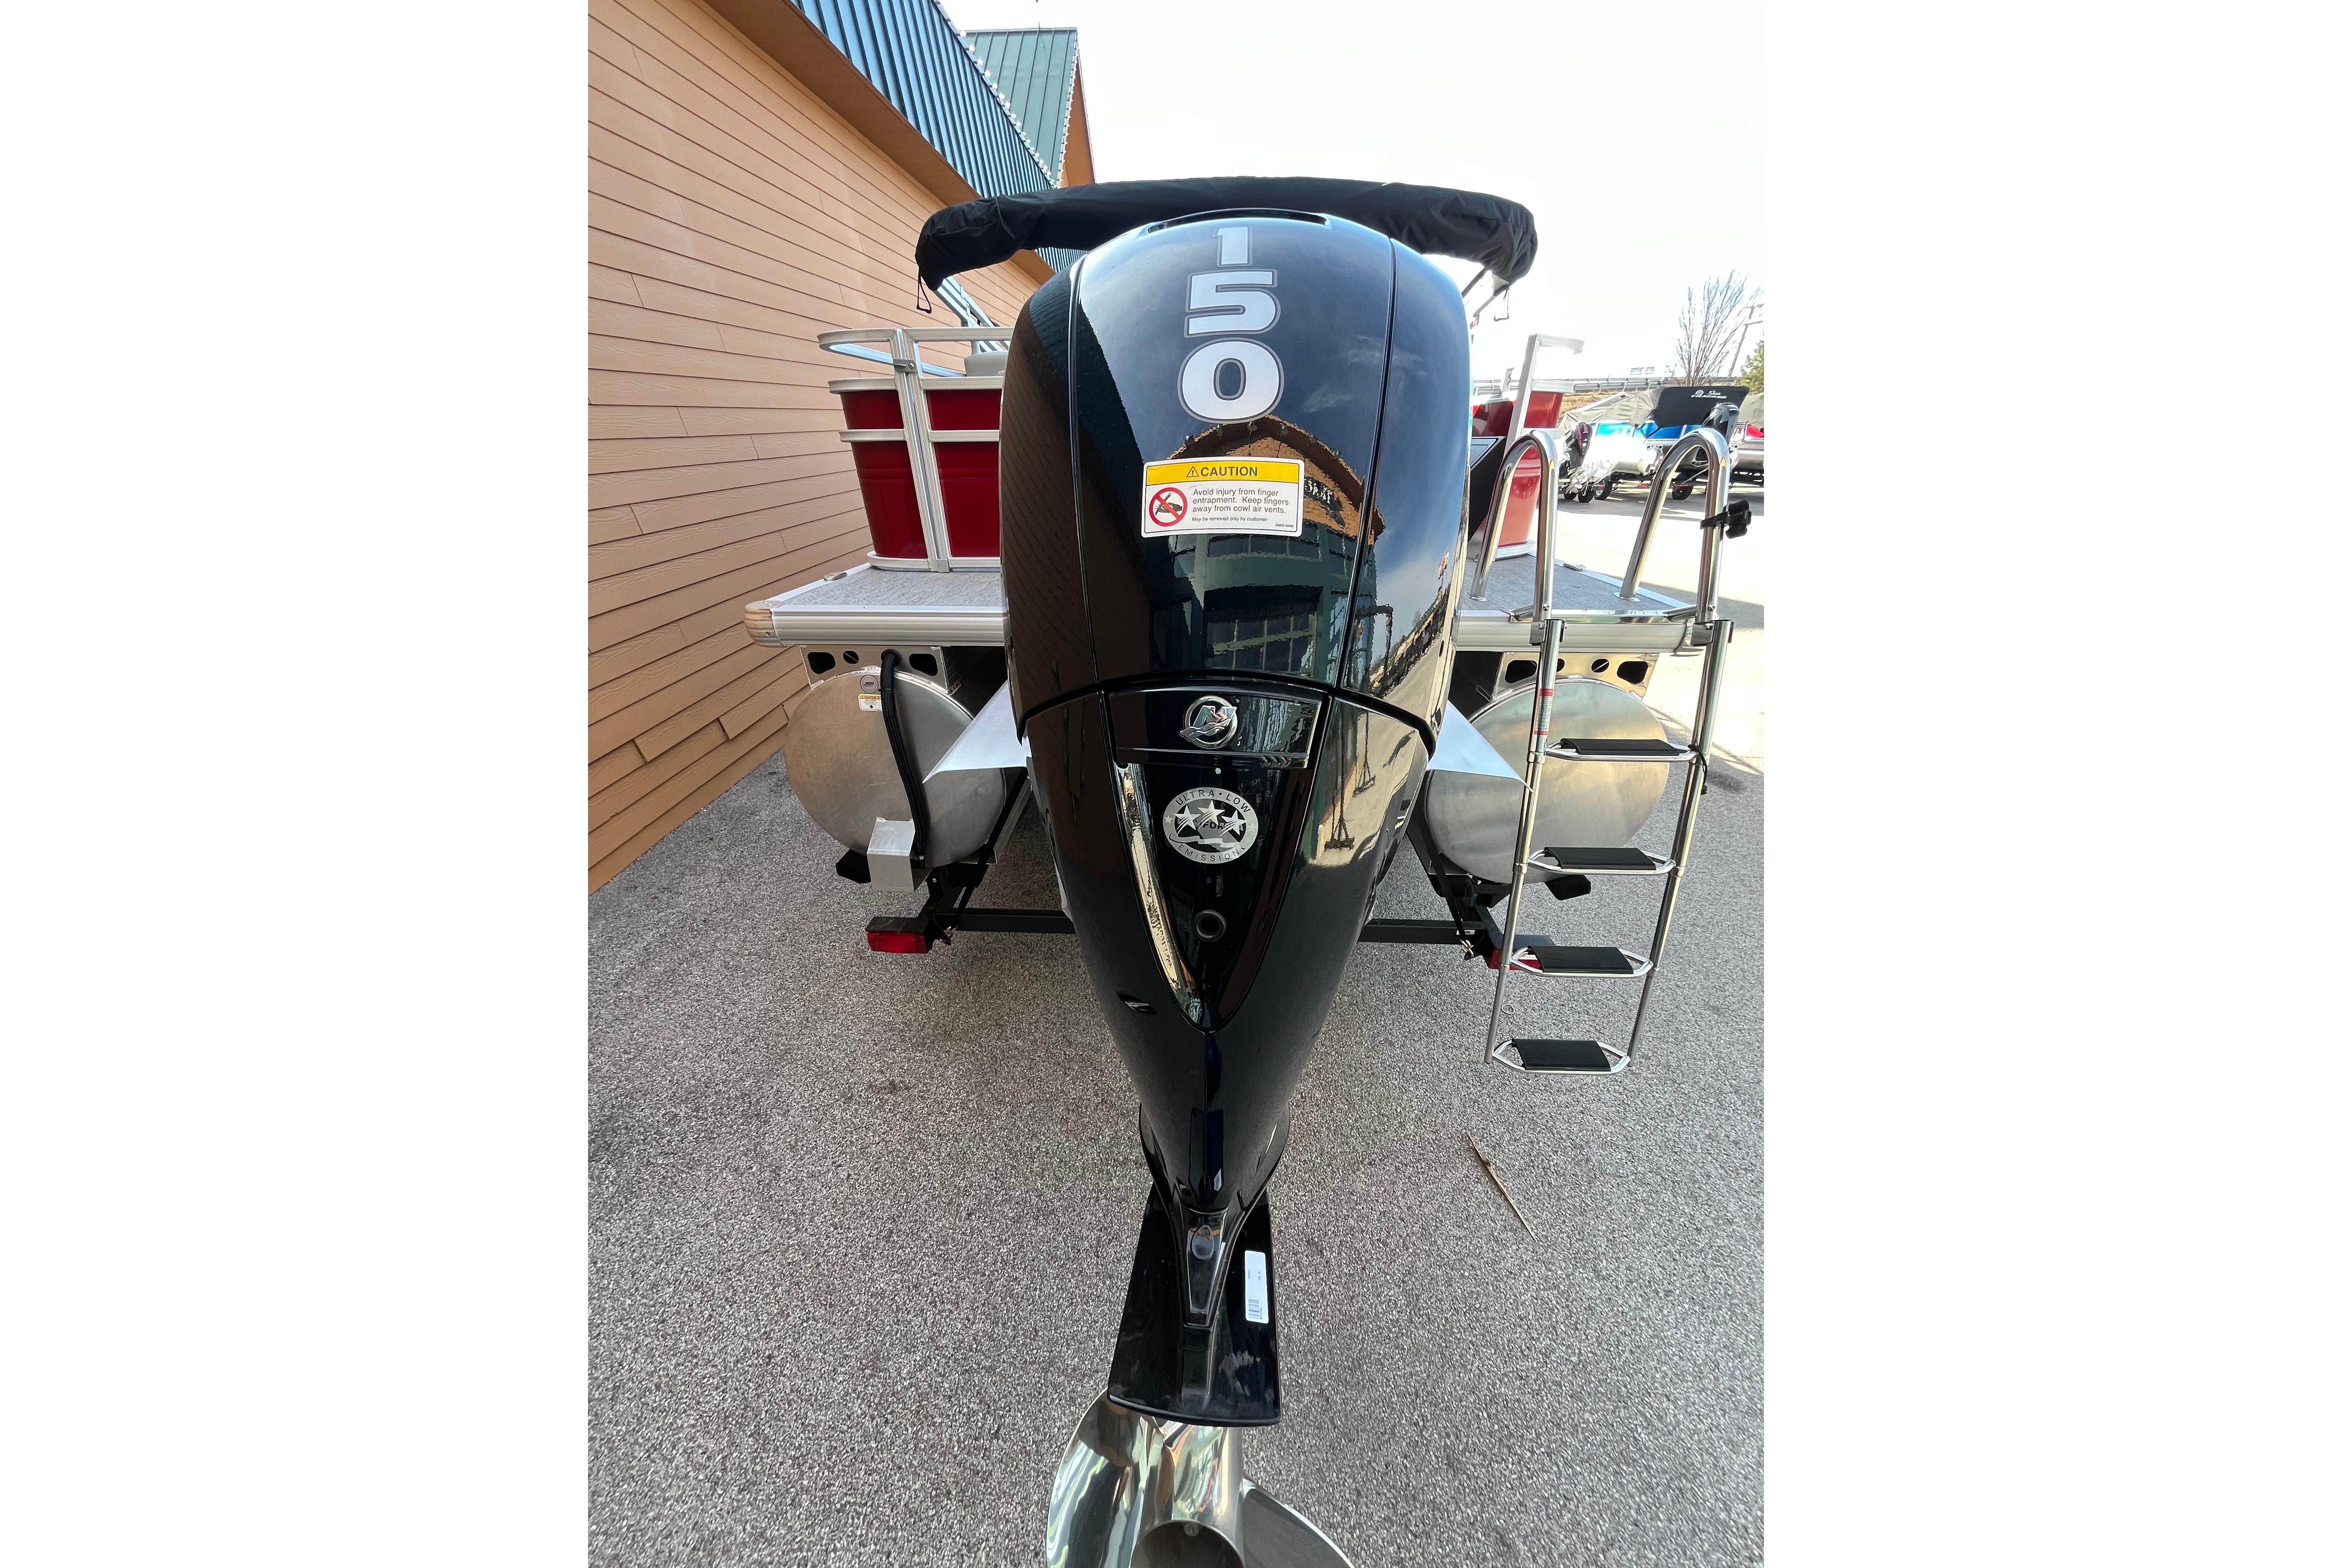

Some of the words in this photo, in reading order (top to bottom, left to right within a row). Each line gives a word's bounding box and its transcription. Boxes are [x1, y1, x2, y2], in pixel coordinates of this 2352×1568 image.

[1178, 225, 1284, 424] 150
[1200, 466, 1257, 477] CAUTION
[1216, 488, 1236, 497] injury
[1257, 488, 1279, 498] finger
[1193, 497, 1237, 505] entrapment.
[1242, 496, 1262, 505] Keep
[1264, 497, 1289, 506] fingers
[1176, 789, 1214, 806] ULTRA
[1226, 793, 1251, 813] LOW
[1178, 844, 1240, 862] EMISSION
